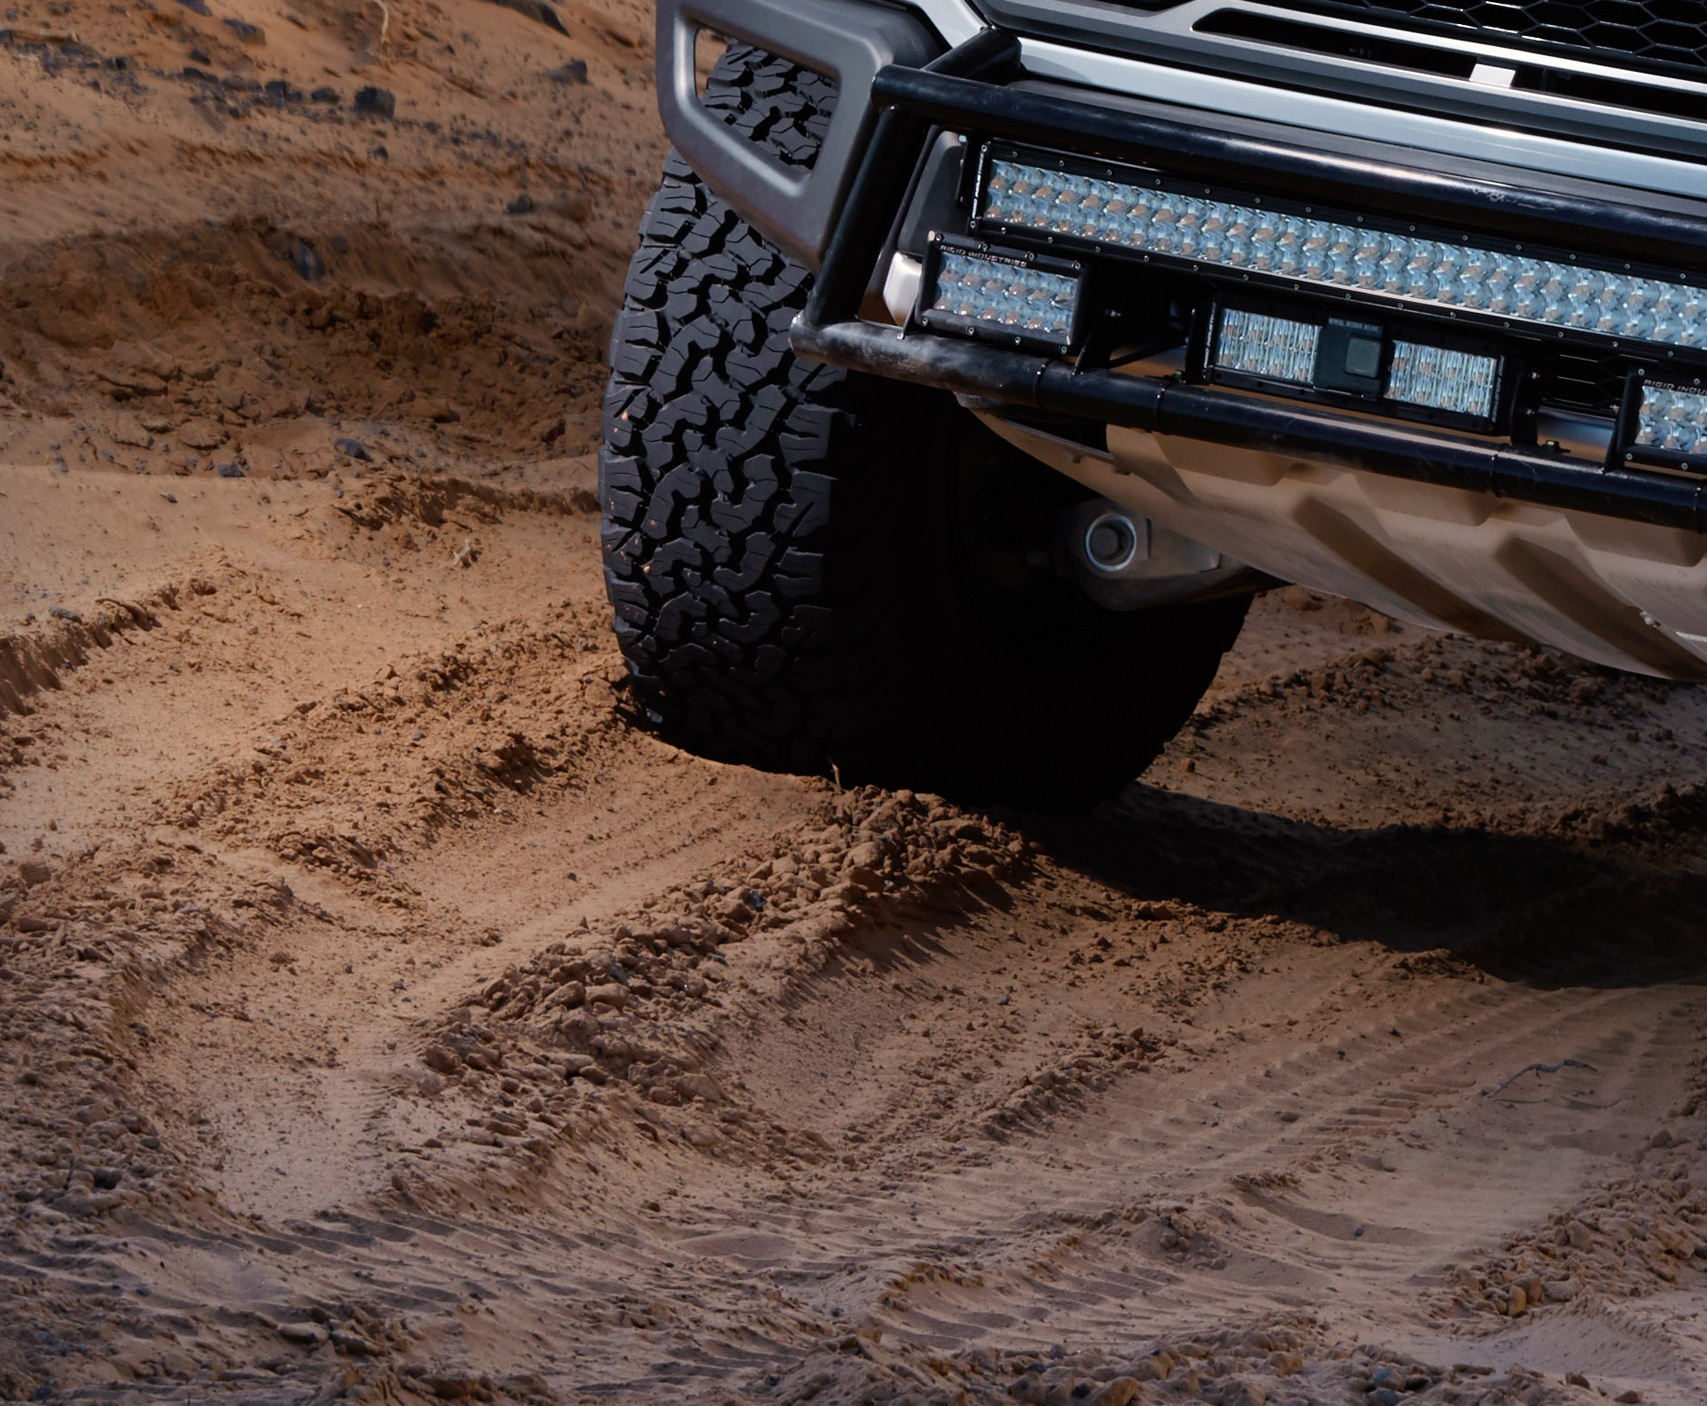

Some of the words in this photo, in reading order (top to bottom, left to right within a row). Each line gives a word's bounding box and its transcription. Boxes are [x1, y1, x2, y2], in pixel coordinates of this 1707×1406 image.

[940, 244, 966, 256] RIGID
[968, 251, 1027, 268] INDUSTRIES
[1643, 379, 1675, 391] RIGID
